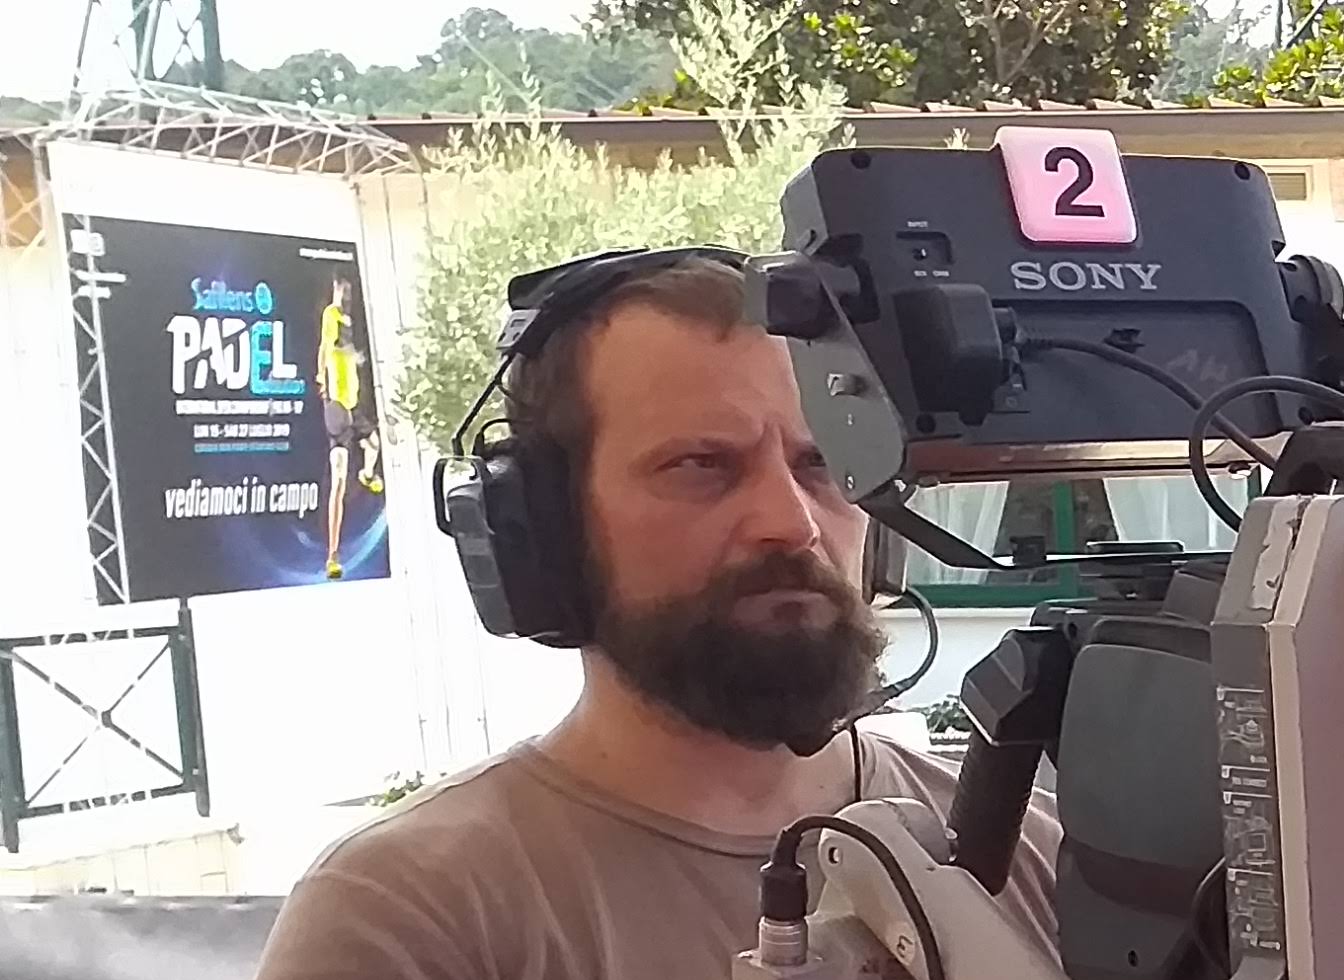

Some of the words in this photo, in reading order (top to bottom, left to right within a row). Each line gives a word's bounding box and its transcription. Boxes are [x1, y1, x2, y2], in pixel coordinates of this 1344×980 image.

[1043, 146, 1105, 218] 2
[1010, 261, 1162, 292] SONY
[166, 315, 306, 395] PADEL
[165, 477, 249, 519] vediamoci
[250, 476, 267, 513] in
[269, 482, 319, 519] campo
